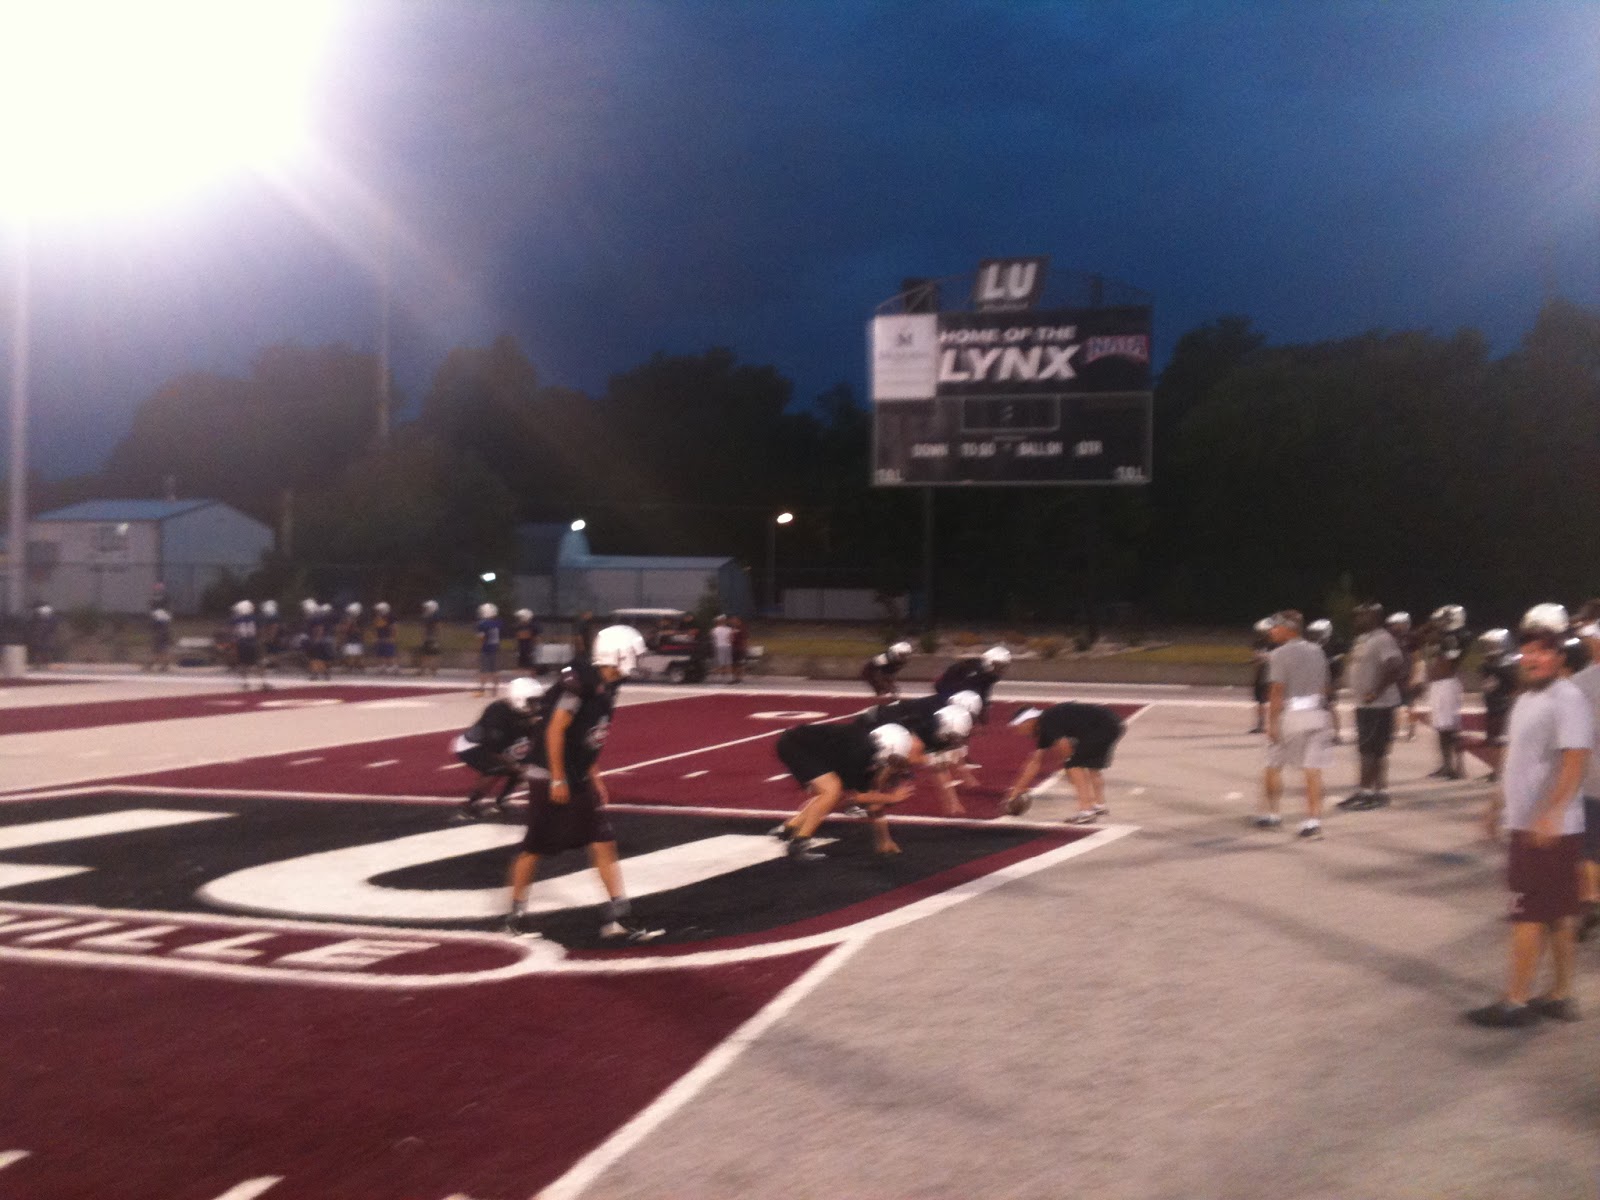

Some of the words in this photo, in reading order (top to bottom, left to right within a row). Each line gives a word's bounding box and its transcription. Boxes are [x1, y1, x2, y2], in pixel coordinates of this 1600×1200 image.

[981, 262, 1038, 301] LU
[939, 330, 1000, 344] HOME
[1003, 328, 1033, 342] OF
[1036, 325, 1077, 341] THE
[938, 344, 1081, 383] LYNX
